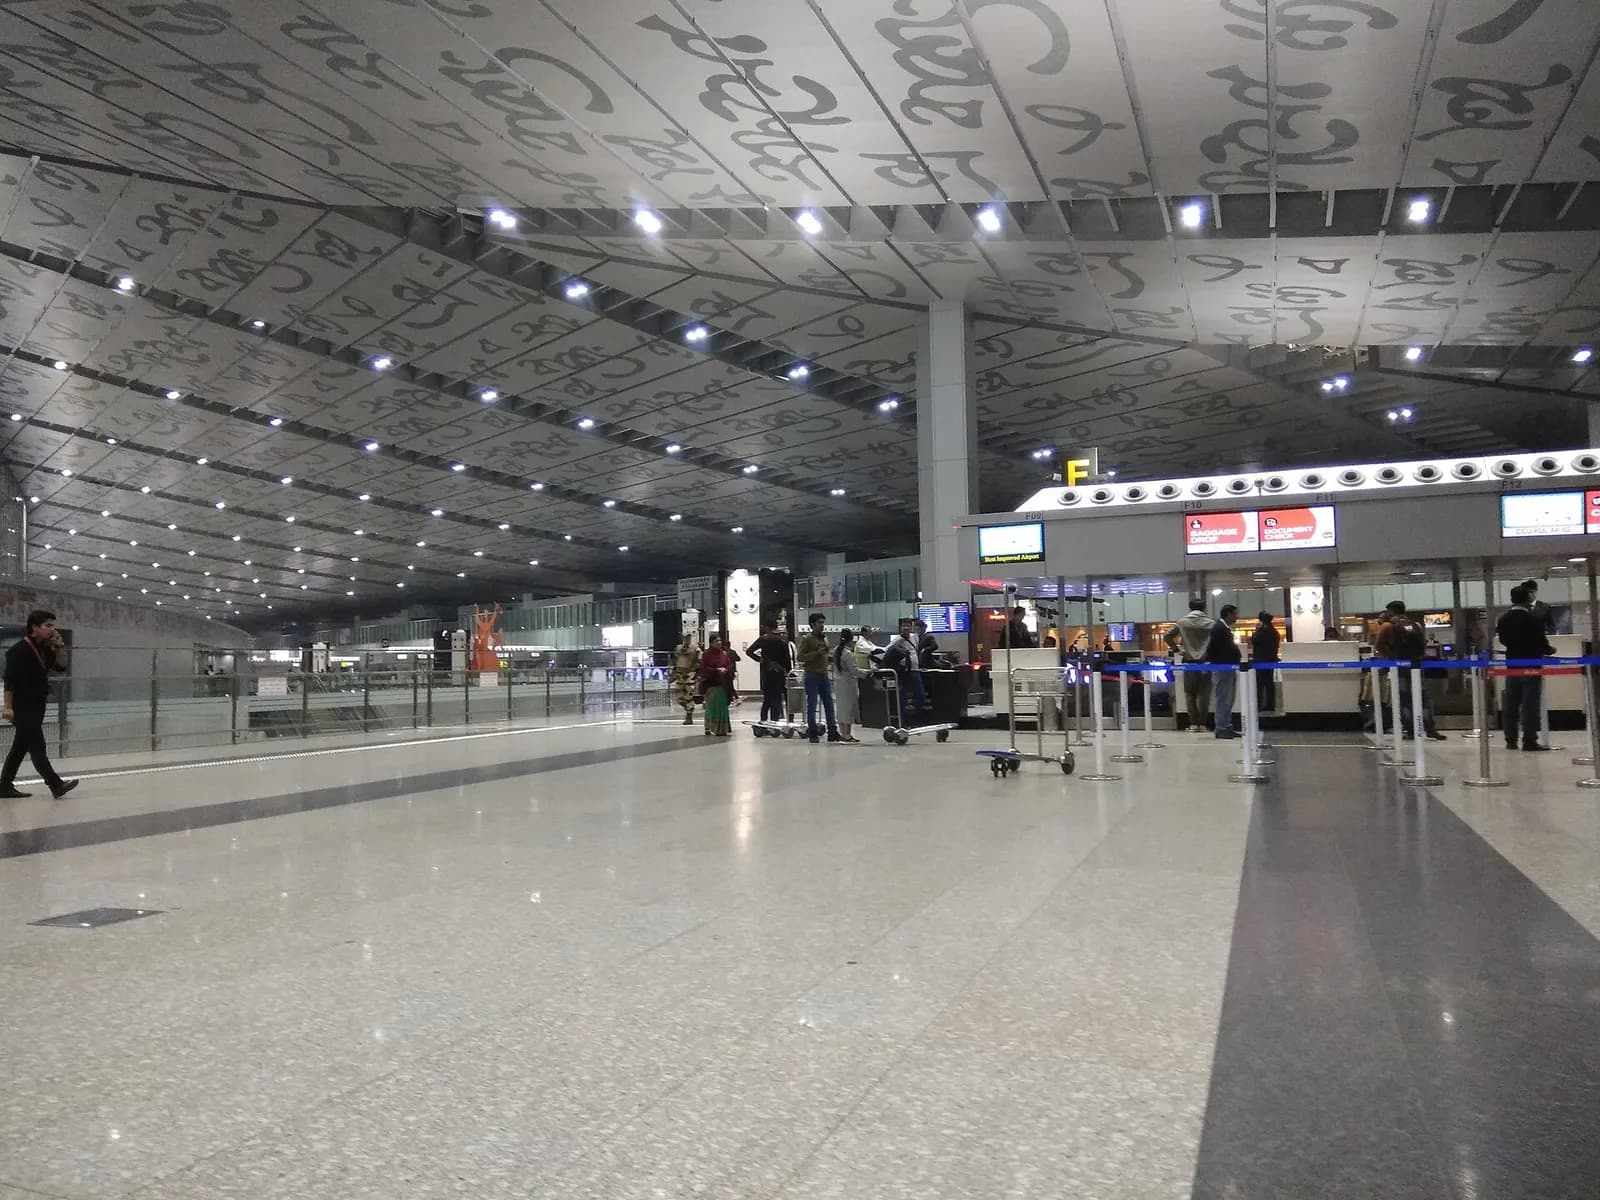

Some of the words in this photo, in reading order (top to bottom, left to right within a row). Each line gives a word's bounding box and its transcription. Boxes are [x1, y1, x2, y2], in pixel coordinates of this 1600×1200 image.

[1067, 459, 1090, 488] F
[1502, 480, 1522, 489] F12
[1316, 494, 1334, 502] F11
[1184, 501, 1202, 510] F10
[1025, 511, 1042, 520] F09
[1190, 528, 1239, 537] BAGGAGE
[1263, 526, 1314, 535] DOCUMENT
[1190, 536, 1219, 544] DROP
[1264, 533, 1294, 541] CHECK
